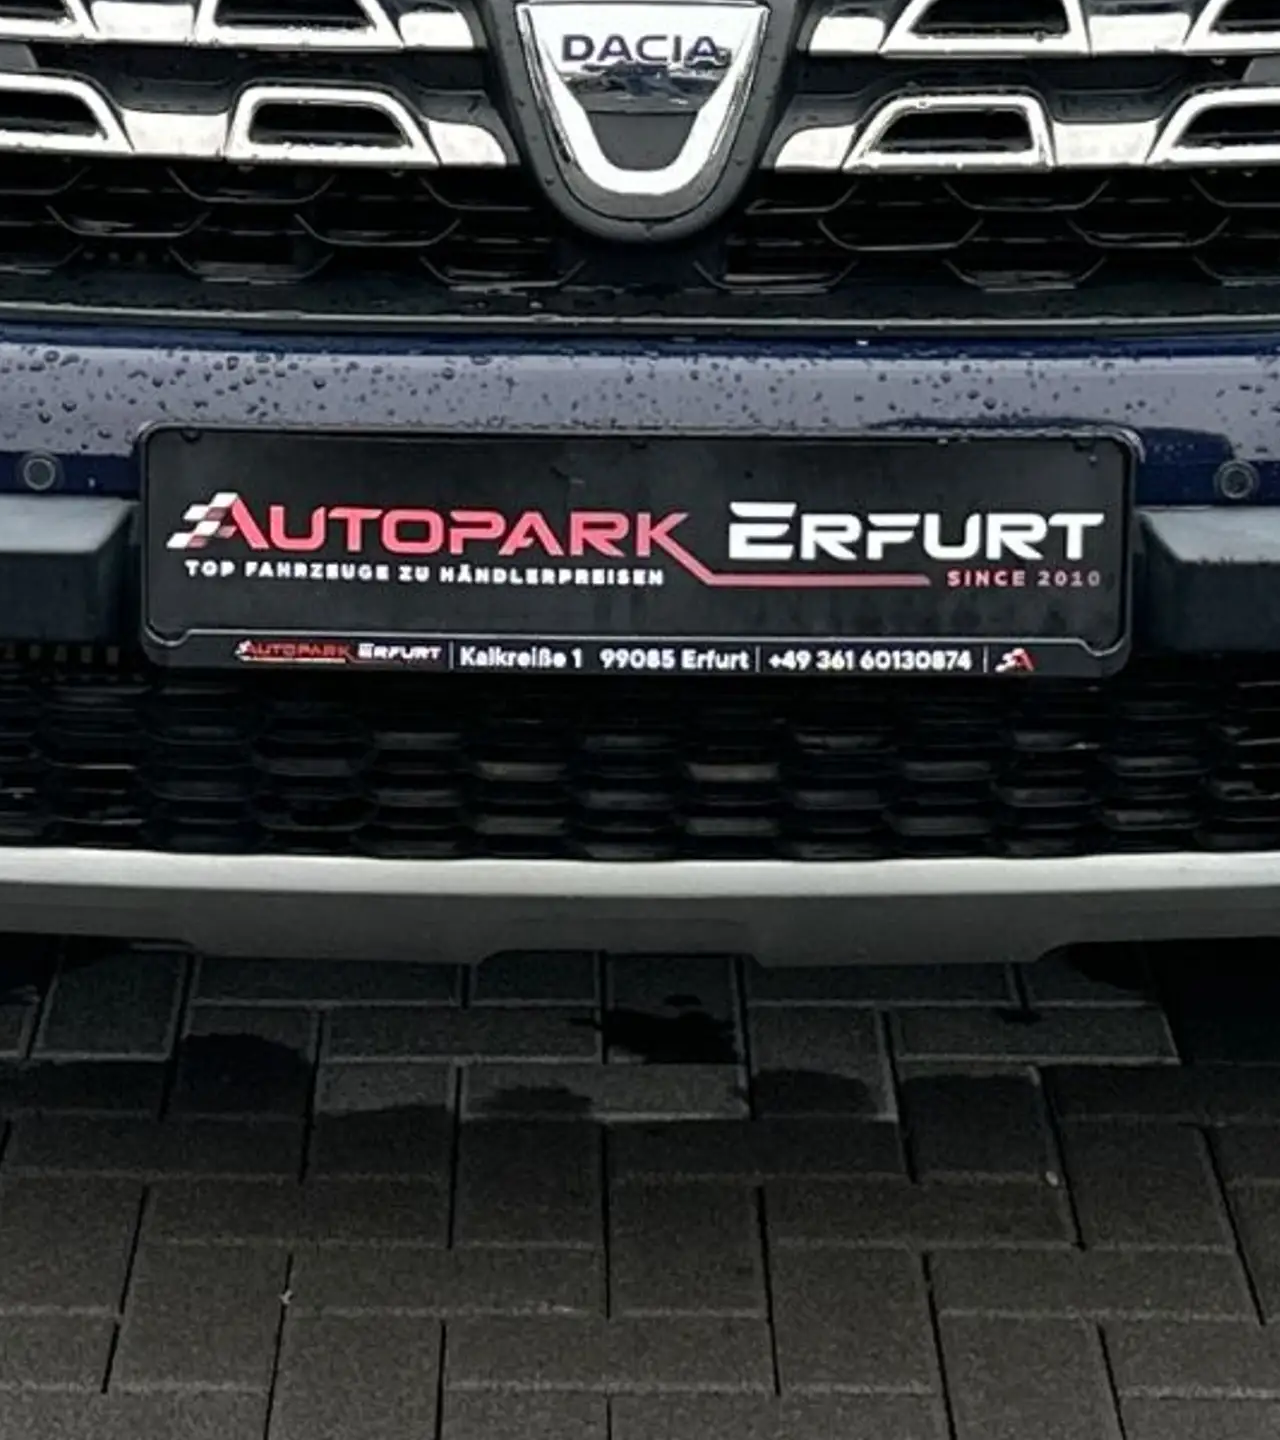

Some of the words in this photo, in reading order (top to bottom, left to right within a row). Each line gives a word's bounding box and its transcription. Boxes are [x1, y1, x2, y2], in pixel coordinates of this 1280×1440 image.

[562, 34, 720, 63] DACIA
[167, 492, 688, 558] AUTOPARK
[728, 501, 1105, 560] ERFURT
[185, 559, 234, 578] TOP
[245, 561, 389, 581] FAHRZEUGE
[398, 564, 430, 582] ZU
[441, 563, 665, 586] HÄNDLERPREISEN
[946, 569, 1026, 587] SINCE
[1037, 569, 1101, 587] 2010
[236, 640, 353, 659] AUTOPARK
[357, 642, 442, 661] ERFURT
[459, 646, 567, 669] Kalkreiße
[572, 648, 583, 668] 1
[599, 648, 676, 669] 99085
[681, 649, 749, 671] Erfurt
[768, 649, 810, 671] +49
[815, 650, 853, 671] 361
[860, 650, 972, 672] 60130874
